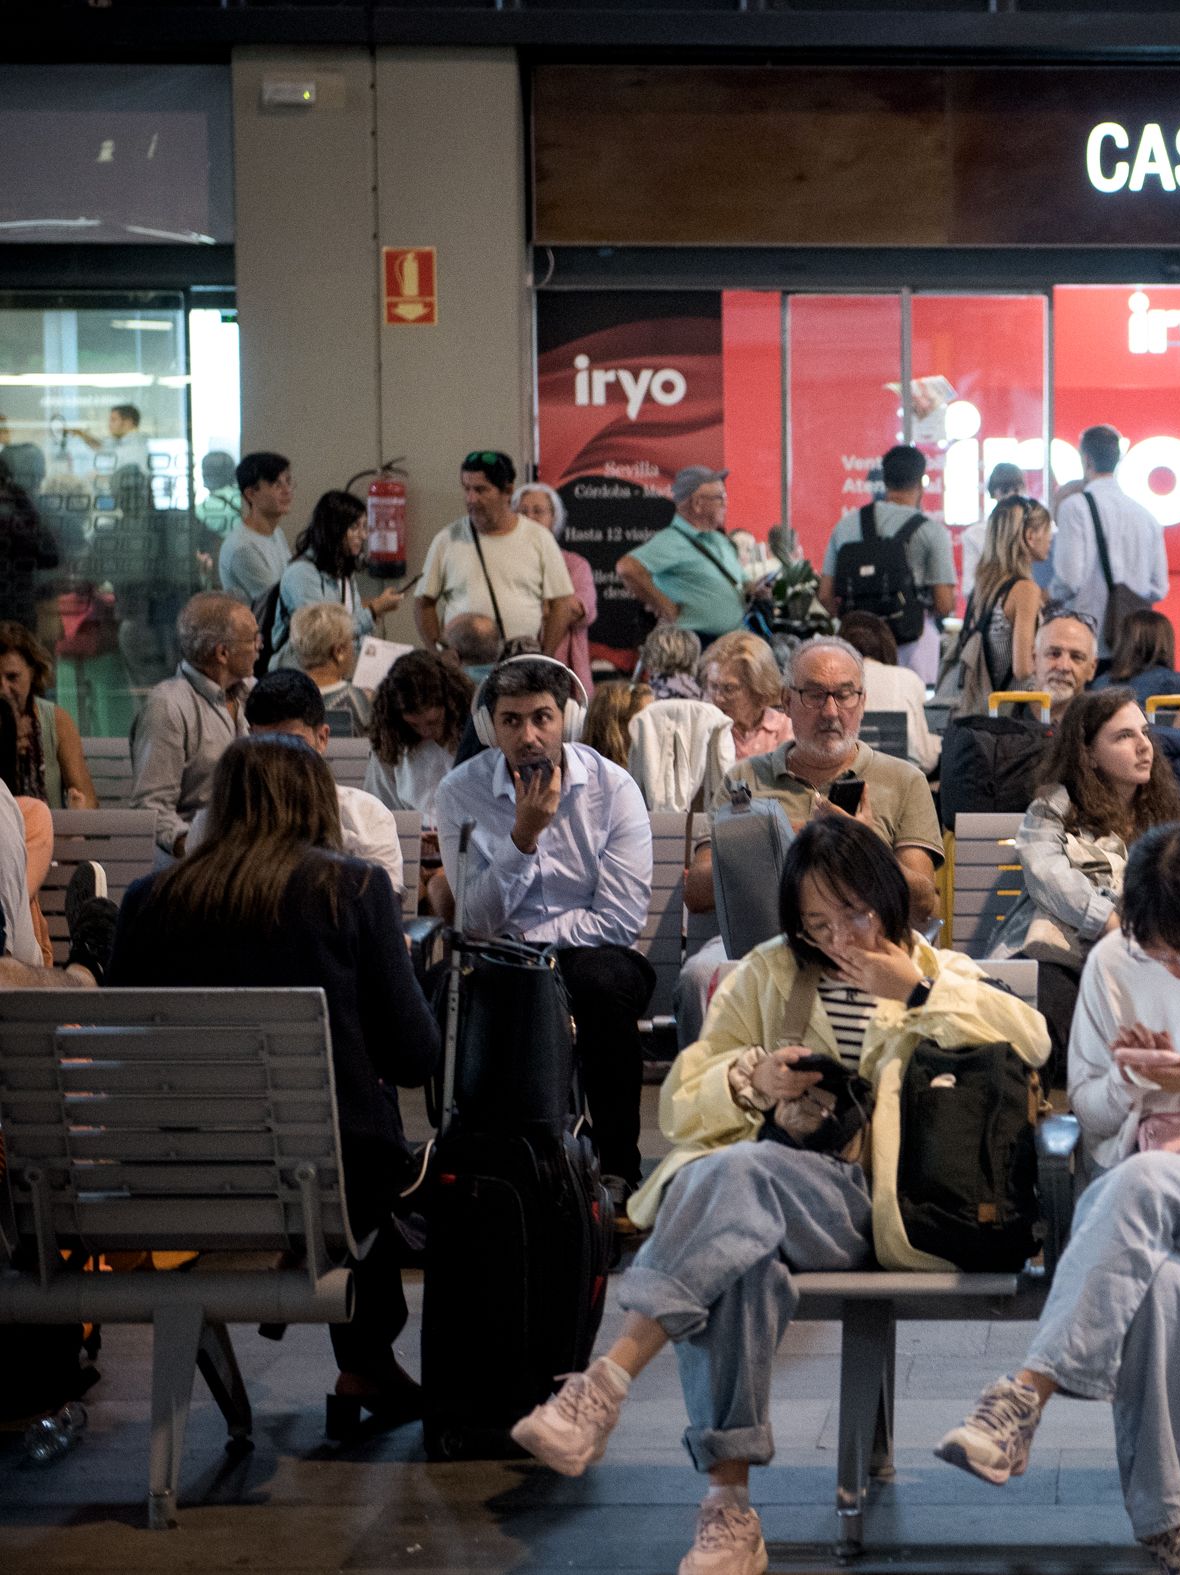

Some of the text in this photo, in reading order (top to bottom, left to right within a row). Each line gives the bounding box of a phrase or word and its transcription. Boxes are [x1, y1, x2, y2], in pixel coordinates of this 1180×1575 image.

[574, 354, 687, 421] iryo
[604, 461, 660, 478] Sevilla
[842, 477, 886, 493] Aten
[564, 527, 603, 542] Hasta
[607, 526, 623, 542] 12
